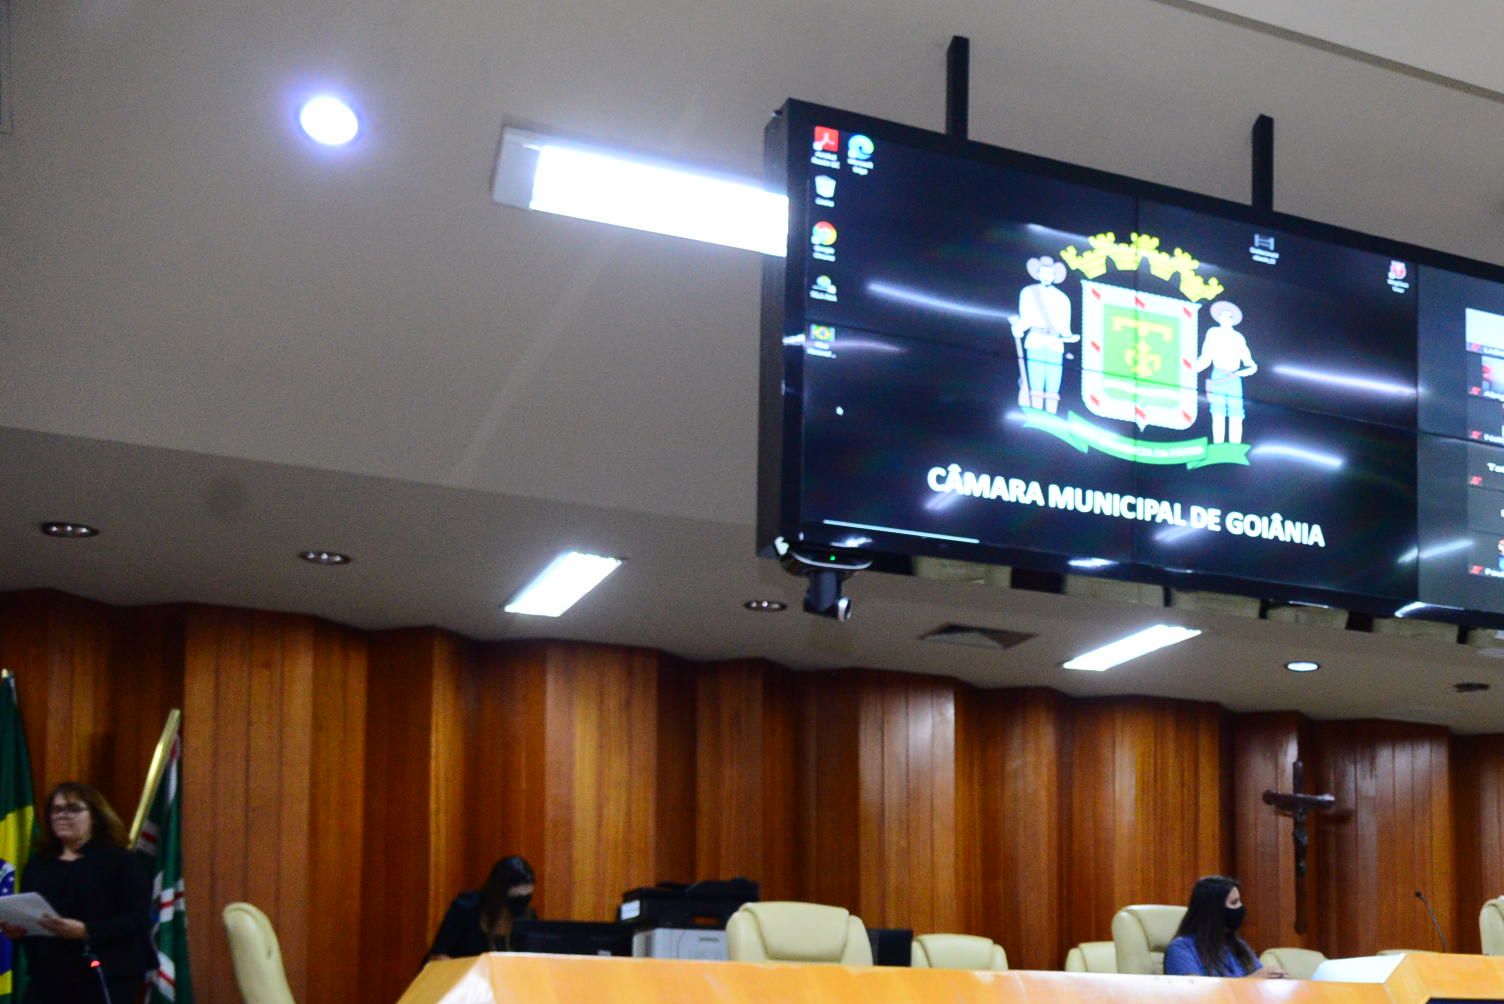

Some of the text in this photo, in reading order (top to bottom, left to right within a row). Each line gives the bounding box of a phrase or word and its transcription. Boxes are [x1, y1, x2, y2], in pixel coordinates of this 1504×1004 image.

[927, 463, 1327, 548] CÂMARA MUNICIPAL DE GOIÂNIA
